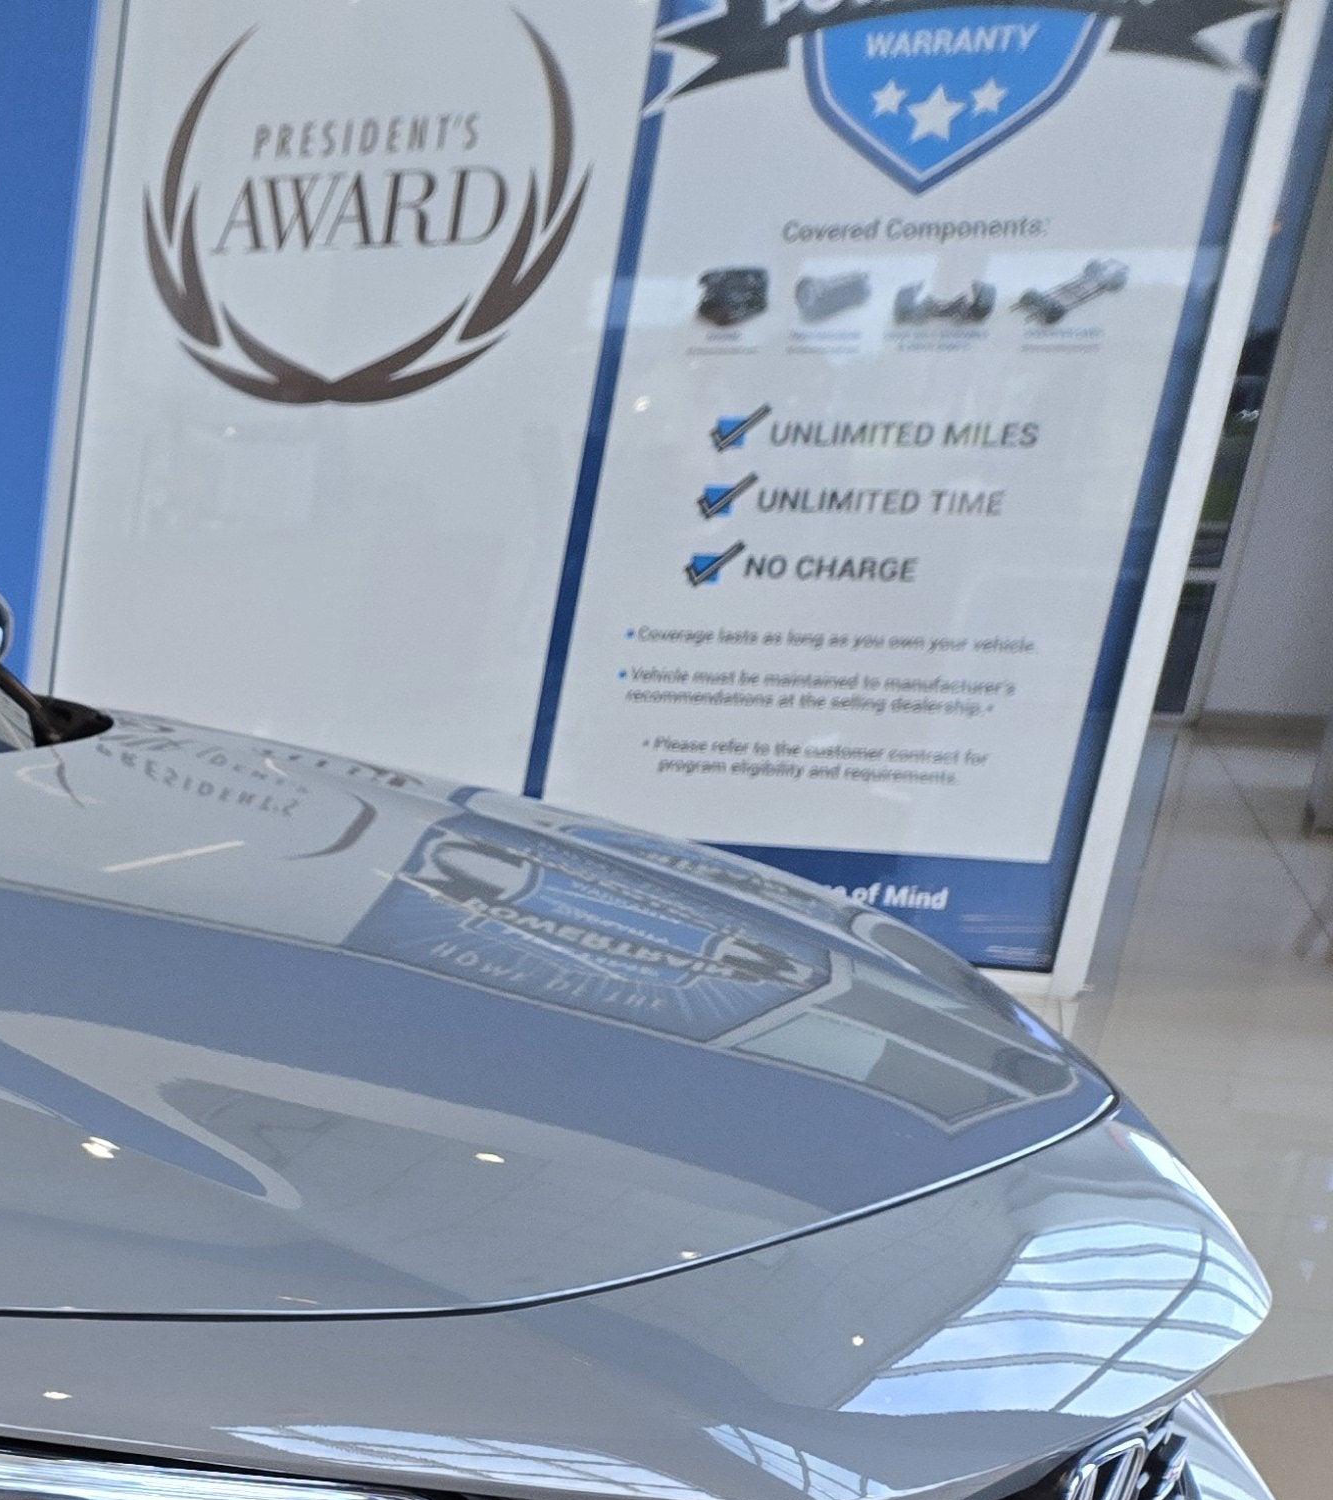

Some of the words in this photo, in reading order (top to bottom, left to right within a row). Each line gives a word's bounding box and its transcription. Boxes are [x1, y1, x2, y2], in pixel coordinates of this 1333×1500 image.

[866, 22, 1040, 59] WARRANTY
[251, 110, 480, 161] PRESIDENT'S
[209, 164, 510, 256] AWARD
[782, 218, 881, 243] Covered
[769, 420, 934, 447] UNLIMITED
[942, 421, 1039, 448] MILES
[756, 486, 921, 515] UNLIMITED
[931, 488, 1006, 517] TIME
[744, 553, 787, 579] NO
[795, 554, 919, 582] CHARGE
[638, 625, 713, 646] Coverage
[718, 627, 758, 644] lasts
[763, 632, 781, 645] as
[787, 628, 824, 650] long
[829, 633, 848, 647] as
[851, 634, 884, 651] you
[888, 635, 924, 649] own
[927, 636, 967, 653] your
[632, 666, 689, 684] Vehicle
[692, 670, 735, 685] must
[739, 669, 760, 686] be
[764, 672, 858, 690] maintained
[863, 674, 881, 690] to
[625, 689, 774, 708] recommendations
[777, 693, 795, 709] at
[799, 692, 826, 710] the
[830, 693, 886, 716] selling
[653, 735, 708, 753] Please
[711, 738, 748, 754] refer
[753, 741, 770, 756] to
[774, 740, 801, 757] the
[804, 744, 883, 760] customer
[887, 748, 959, 765] contract
[964, 748, 988, 766] for
[657, 759, 727, 777] program
[731, 759, 804, 781] eligibility
[807, 763, 841, 780] and
[850, 883, 882, 907] of
[883, 883, 949, 910] Mind
